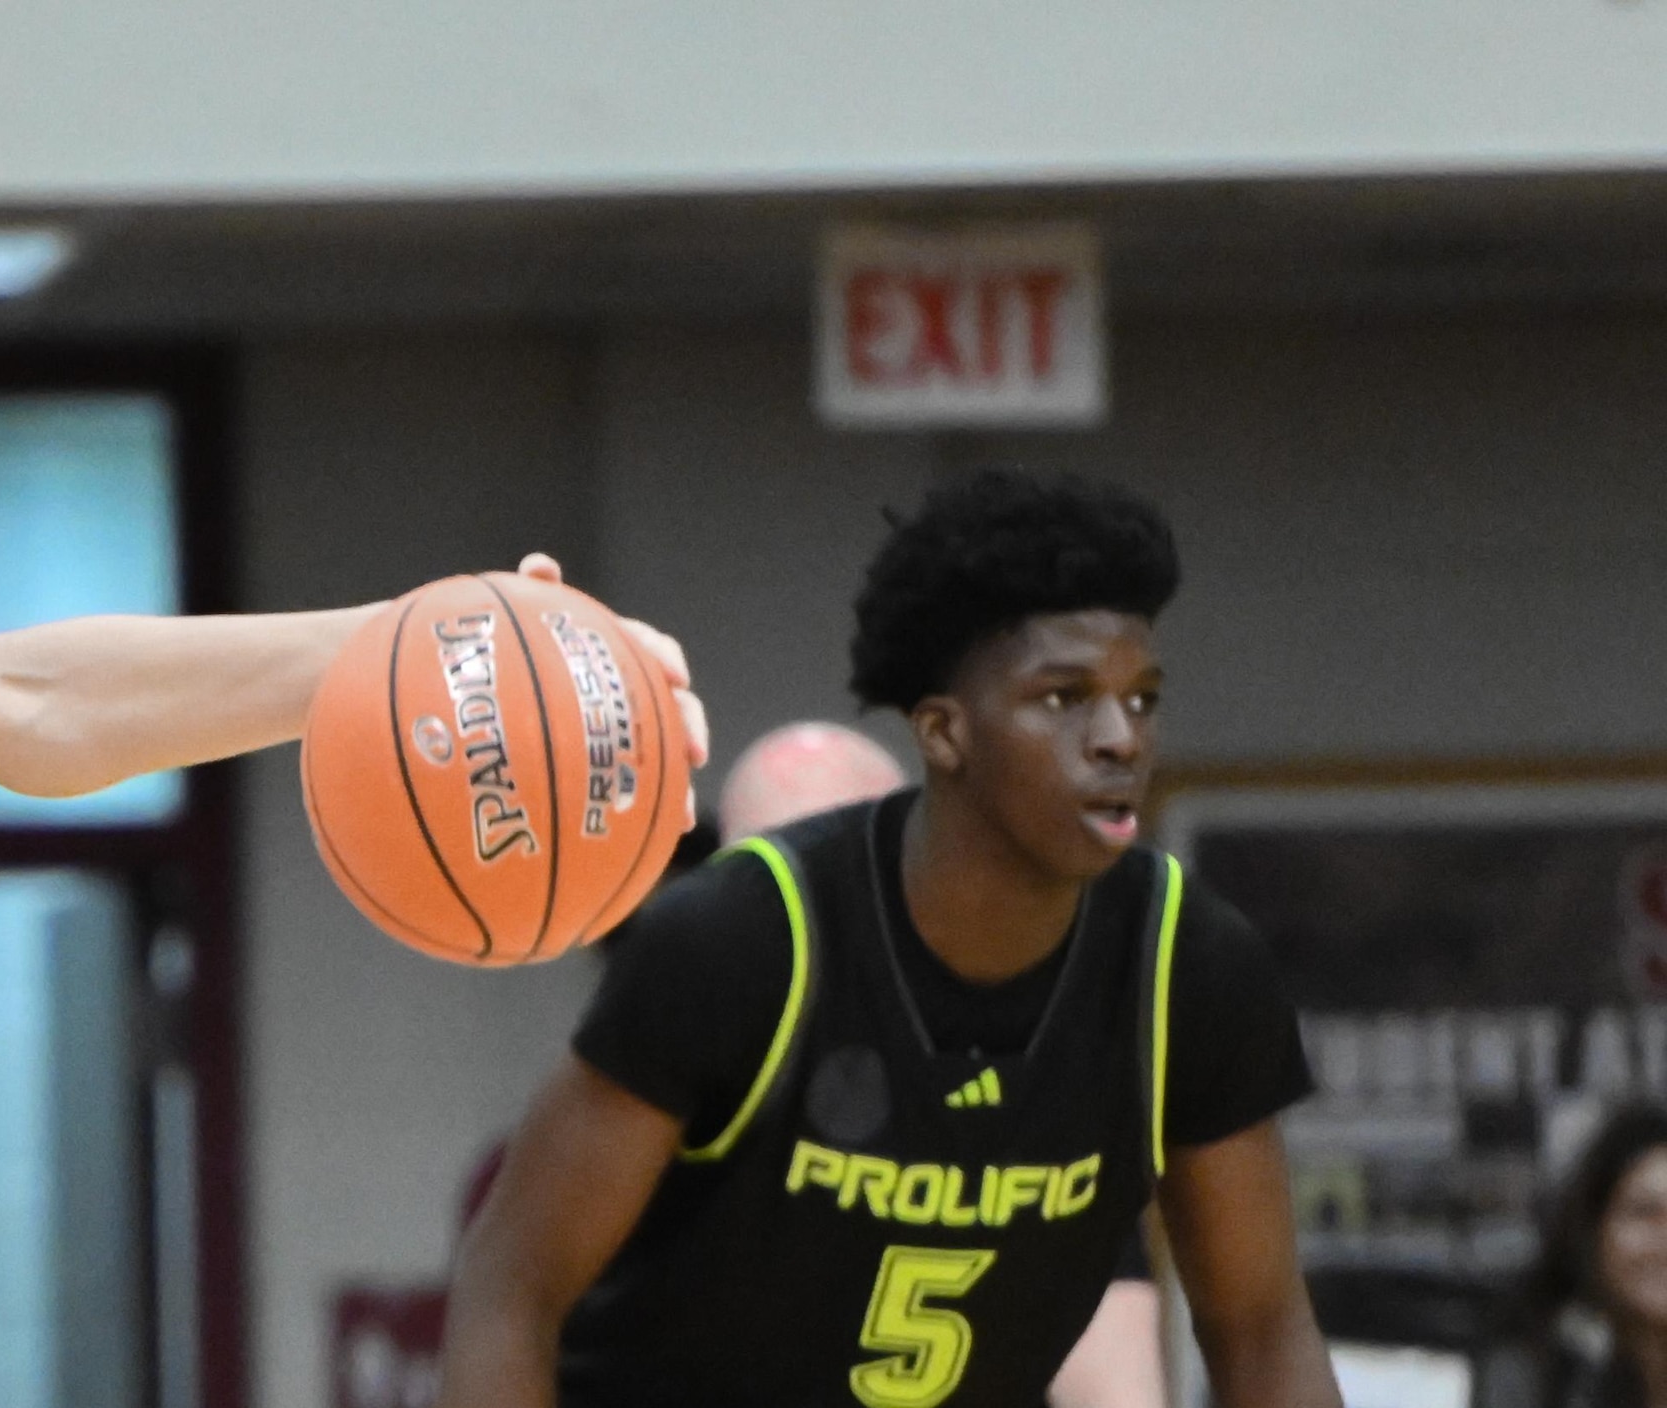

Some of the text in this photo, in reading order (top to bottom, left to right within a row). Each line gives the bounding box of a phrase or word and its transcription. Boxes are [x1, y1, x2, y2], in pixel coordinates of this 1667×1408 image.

[843, 266, 1071, 388] EXIT
[433, 612, 539, 865] SPALDING
[785, 1138, 1103, 1228] PROLIFIC
